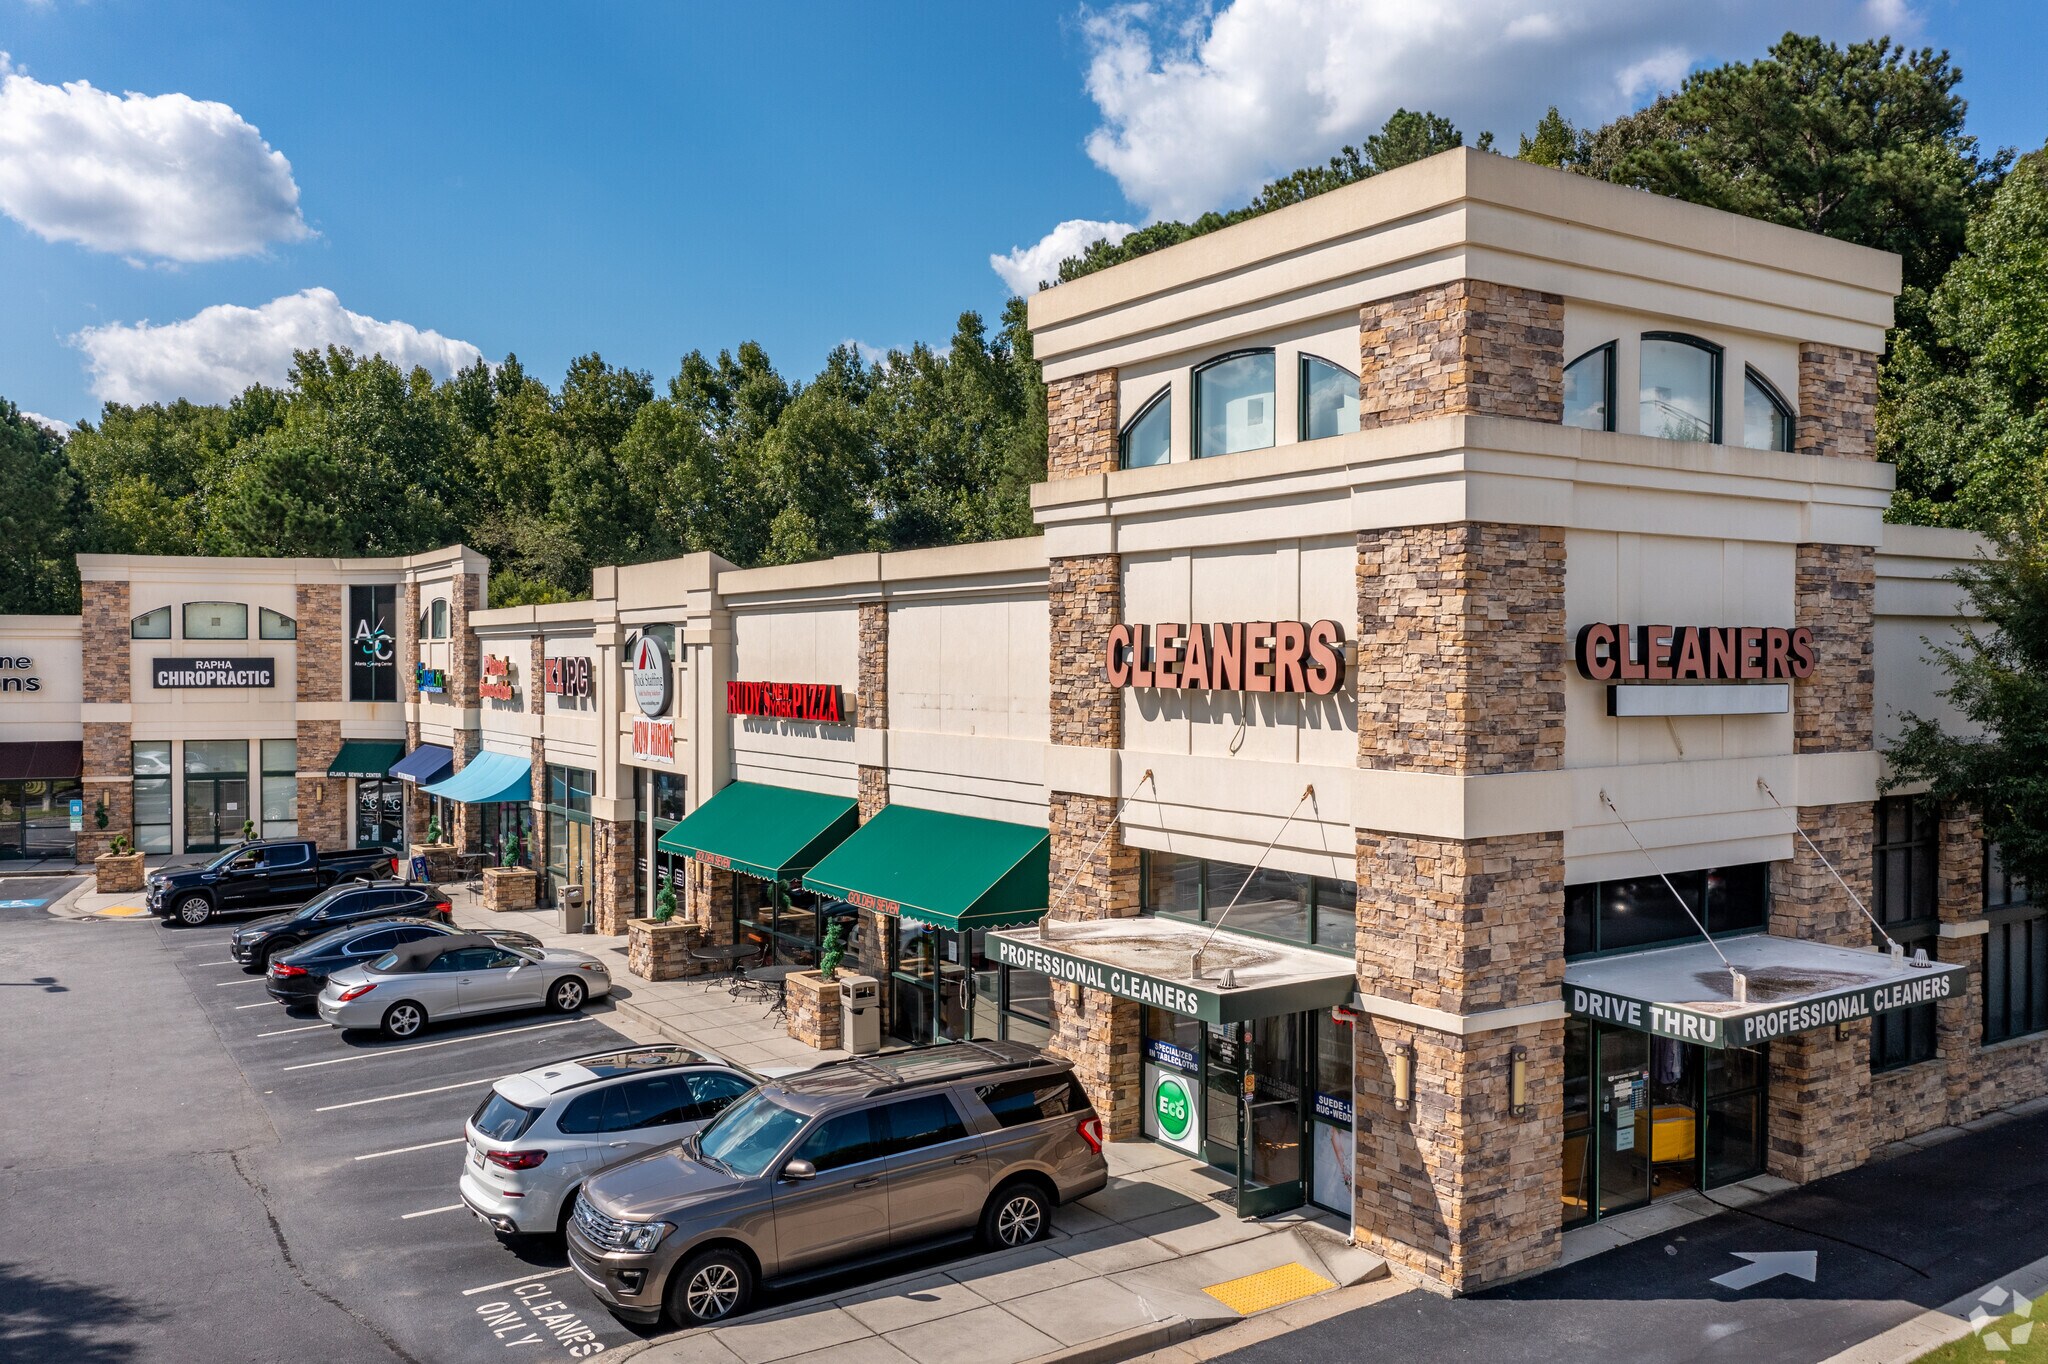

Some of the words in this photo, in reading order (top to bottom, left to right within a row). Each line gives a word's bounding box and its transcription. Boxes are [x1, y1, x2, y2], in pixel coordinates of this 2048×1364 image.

[195, 660, 232, 669] RAPHA
[1107, 620, 1346, 696] CLEANERS
[1576, 622, 1817, 681] CLEANERS
[158, 670, 270, 686] CHIROPRACTIC
[566, 656, 588, 697] PC
[771, 683, 790, 700] NEW
[727, 681, 771, 717] RUDY'S
[770, 700, 792, 718] YORK
[792, 683, 840, 722] PIZZA
[634, 721, 648, 755] NOW
[651, 722, 673, 759] HIRING
[848, 891, 875, 909] GOLDEN
[876, 898, 900, 915] SEVEN
[1000, 942, 1106, 989] PROFESSIONAL
[1110, 972, 1199, 1015] CLEANERS
[1574, 989, 1641, 1026] DRIVE
[1649, 1006, 1716, 1043] THRU
[1744, 991, 1870, 1042] PROFESSIONAL
[1873, 975, 1951, 1012] CLEANERS
[1149, 1049, 1156, 1058] IN
[1157, 1051, 1199, 1072] TABLECLOTHS
[1154, 1043, 1193, 1061] SPECIALIZED
[1159, 1095, 1186, 1120] Eco
[476, 1301, 543, 1347] ONLY
[513, 1283, 605, 1358] CLEANRS
